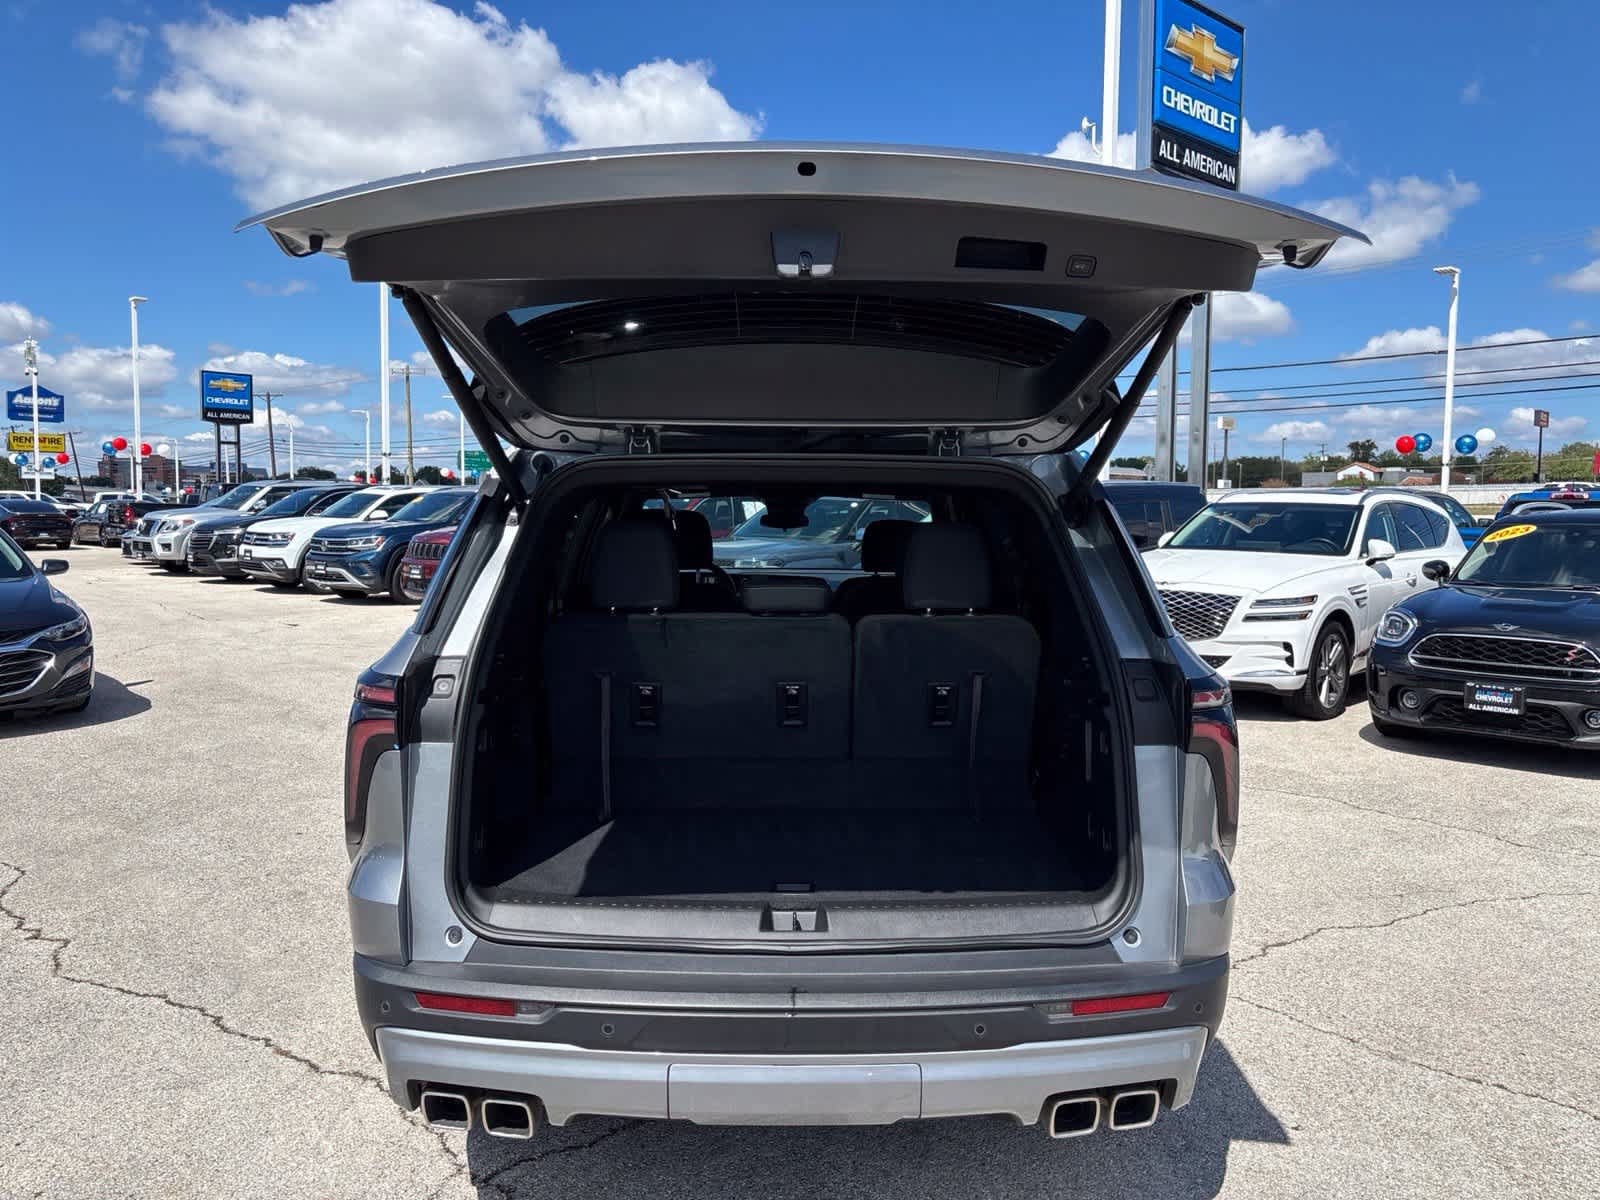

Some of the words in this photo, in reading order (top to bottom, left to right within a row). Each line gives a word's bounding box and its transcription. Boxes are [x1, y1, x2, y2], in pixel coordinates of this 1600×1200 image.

[1162, 85, 1237, 134] CHEVROLET
[1159, 139, 1180, 163] ALL
[1183, 149, 1236, 184] AMERICAN
[12, 393, 61, 406] Aaon's
[206, 396, 249, 406] CHEVROLET
[220, 412, 250, 420] AMERICAN
[1475, 694, 1513, 704] CHEVROLET
[1468, 703, 1481, 711] ALL
[1482, 705, 1519, 715] AMERICAN
